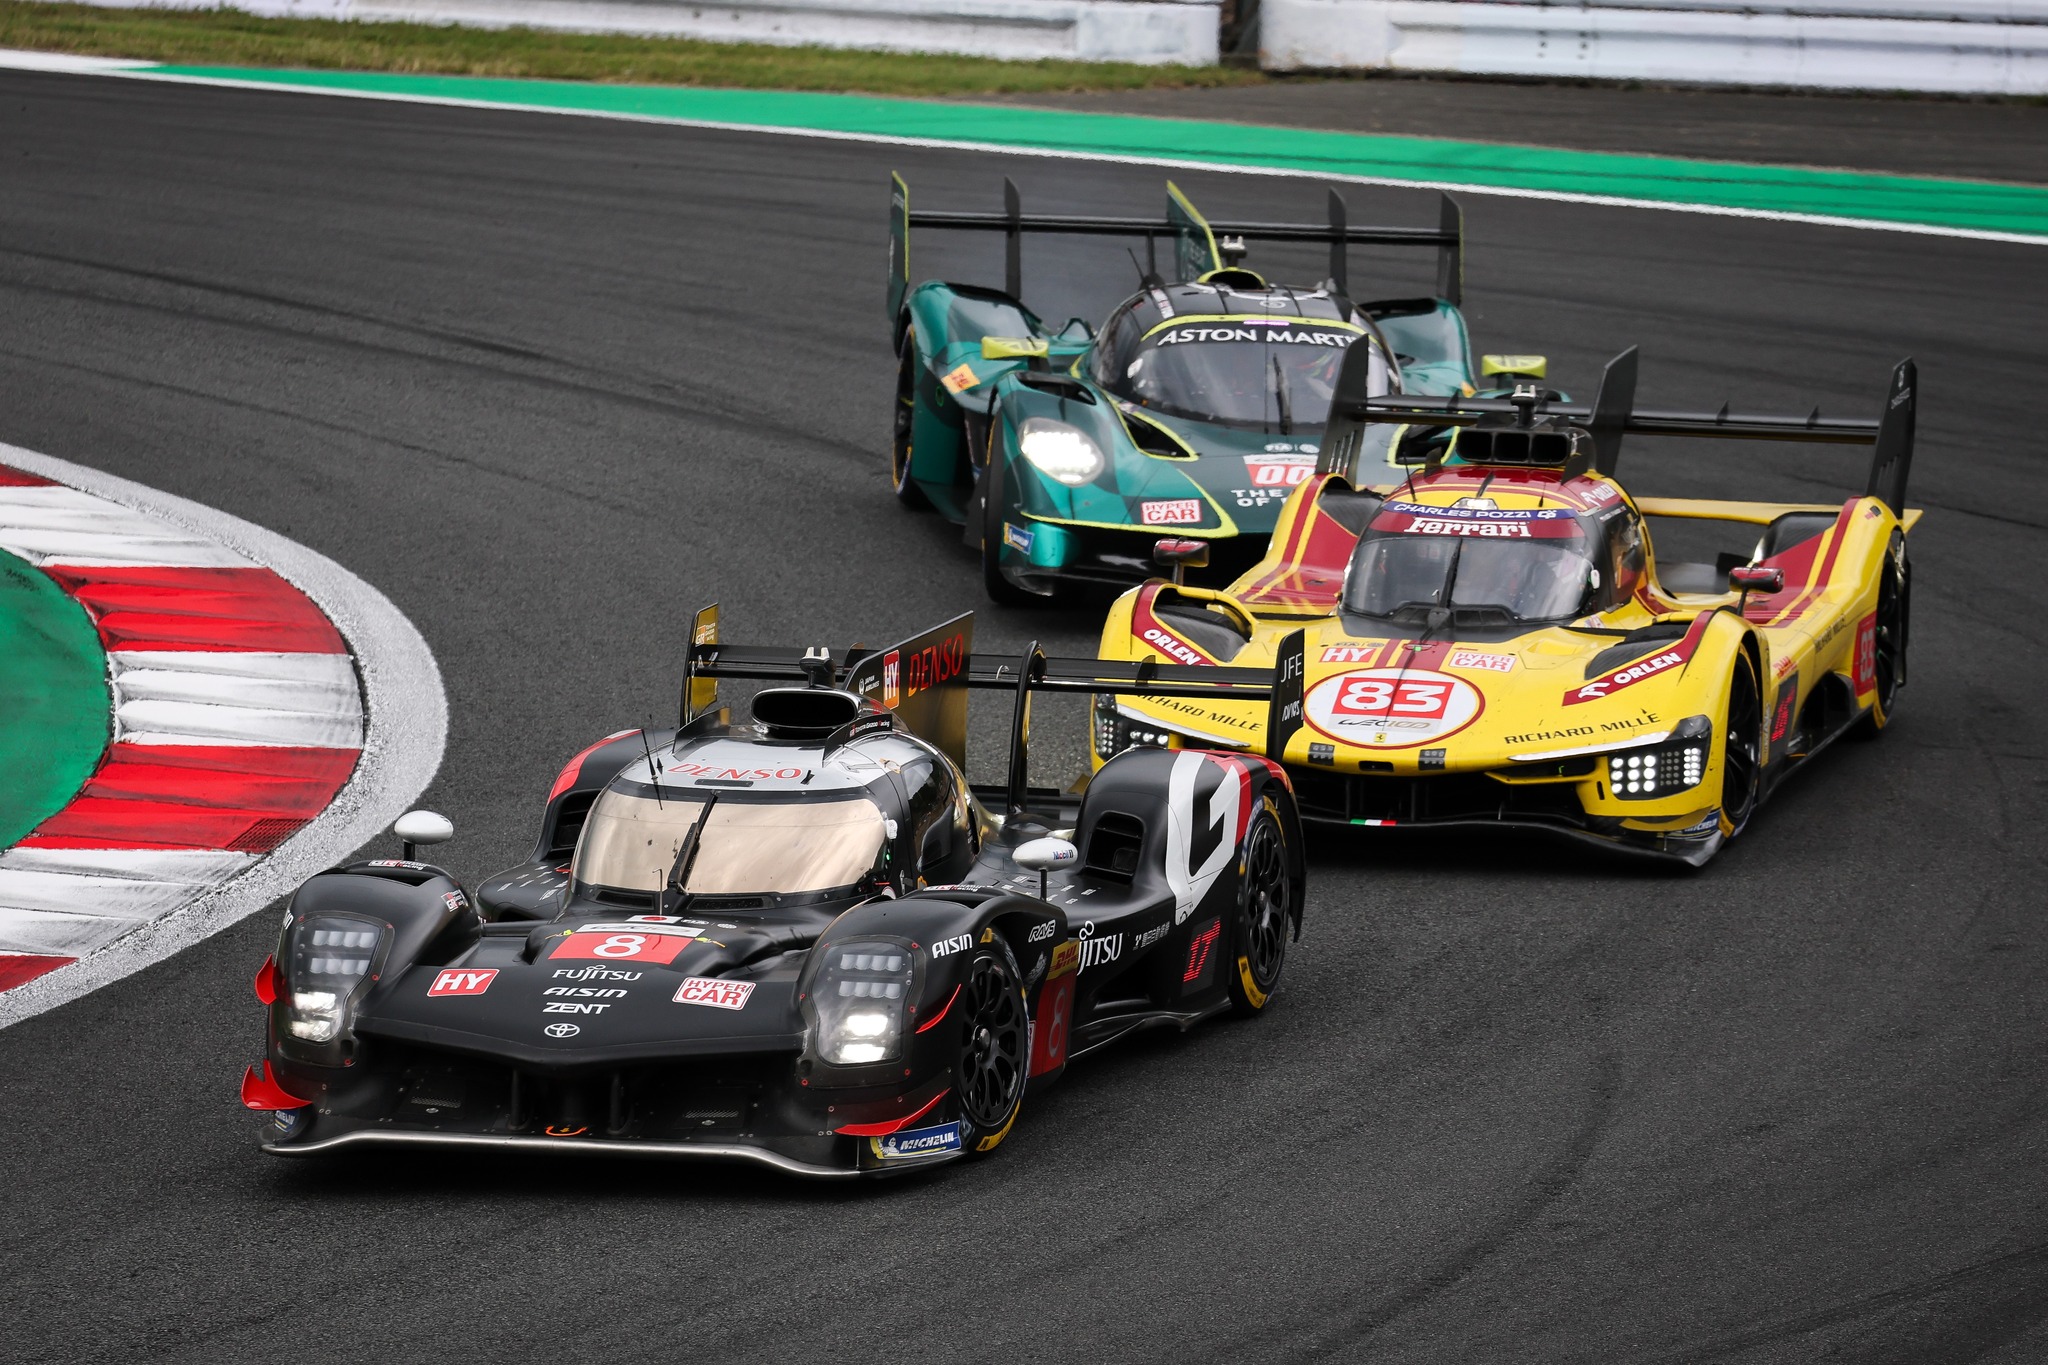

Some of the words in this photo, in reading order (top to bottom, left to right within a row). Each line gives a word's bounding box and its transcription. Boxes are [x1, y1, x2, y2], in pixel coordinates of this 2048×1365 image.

[1157, 328, 1257, 346] ASTON
[1255, 465, 1315, 485] 00
[1231, 489, 1283, 498] THE
[1237, 498, 1271, 507] OF
[1145, 501, 1195, 510] HYPER
[1393, 503, 1472, 518] CHARLES
[1476, 509, 1532, 519] POZZI
[1143, 509, 1195, 521] CAR
[1404, 516, 1532, 537] Ferrari
[1143, 628, 1201, 665] ORLEN
[1322, 648, 1373, 662] HY
[907, 632, 964, 697] DENSO
[1281, 652, 1303, 683] JFE
[1455, 658, 1509, 671] CAR
[1457, 653, 1512, 664] HYPER
[1613, 652, 1683, 684] ORLEN
[884, 660, 899, 700] HY
[1340, 681, 1446, 713] 83
[1207, 712, 1263, 732] MILLE
[1504, 726, 1594, 744] RICHARD
[1600, 713, 1661, 732] MILLE
[667, 763, 802, 780] DENSO
[593, 934, 647, 957] 8
[931, 933, 973, 959] AISIN
[434, 973, 492, 991] HY
[552, 965, 643, 982] FUJITSU
[543, 986, 628, 998] AISIN
[687, 979, 752, 993] HYPER
[681, 987, 744, 1006] CAR
[542, 1002, 611, 1015] ZENT
[1049, 986, 1067, 1058] 8
[900, 1131, 955, 1151] MICHELIN
